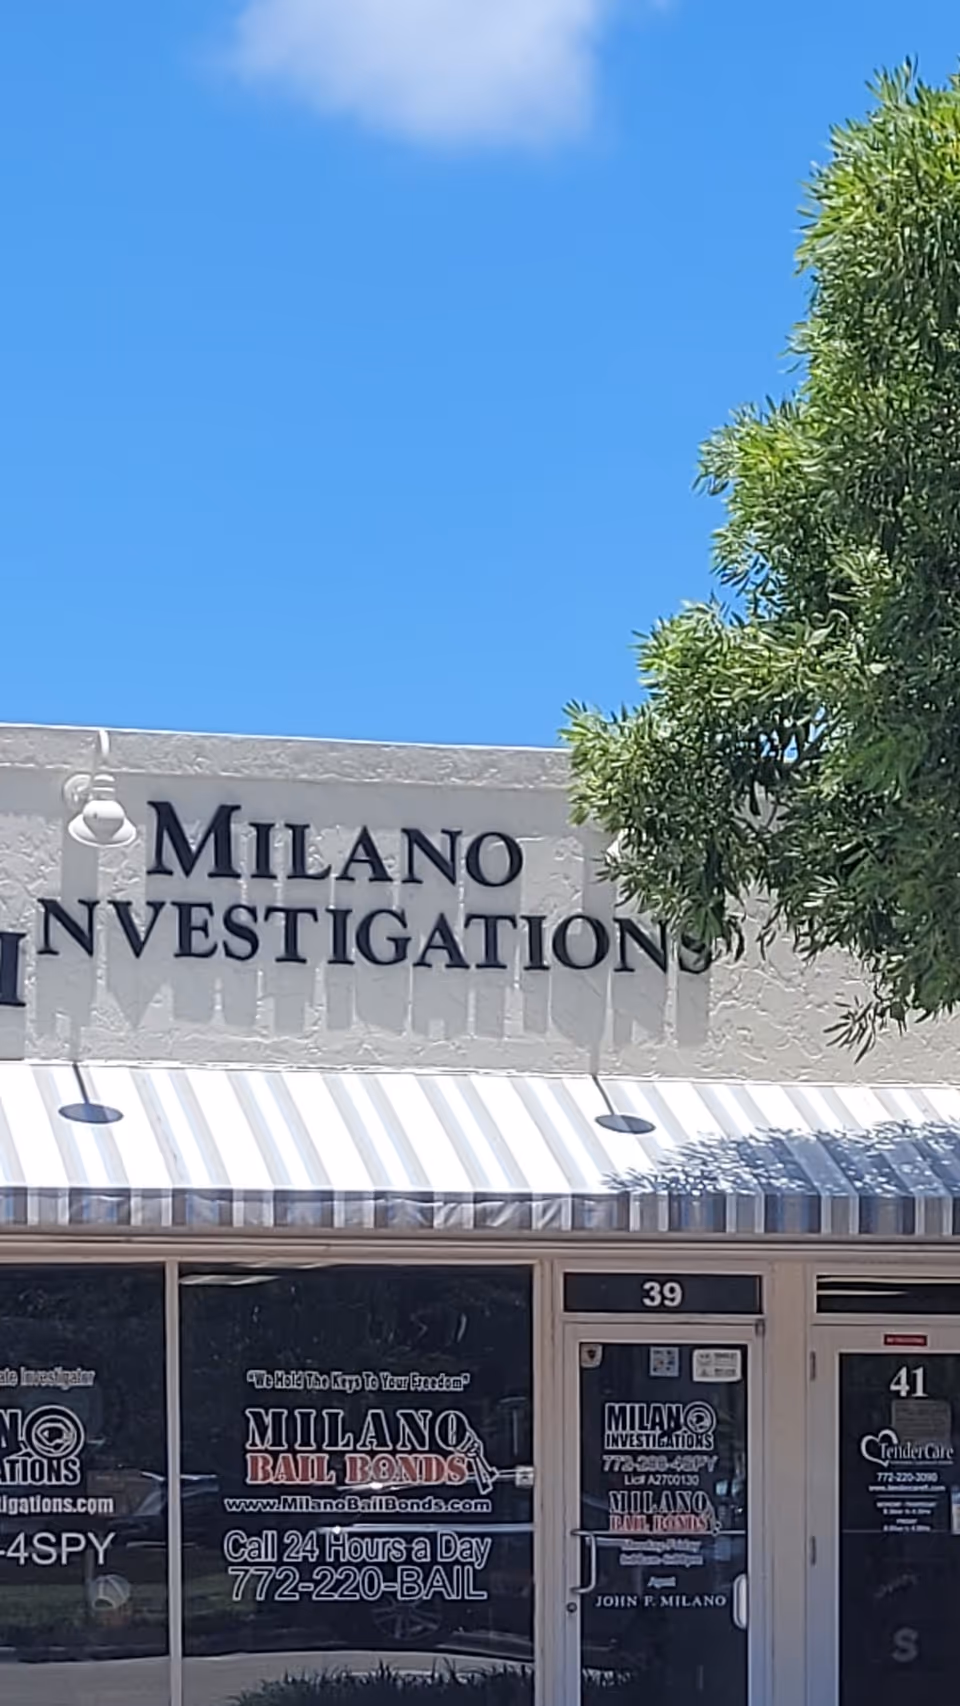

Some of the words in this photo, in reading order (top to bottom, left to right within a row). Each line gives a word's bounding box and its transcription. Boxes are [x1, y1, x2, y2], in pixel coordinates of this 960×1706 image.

[146, 801, 524, 887] MILANO
[642, 1281, 682, 1307] 39
[274, 1370, 302, 1389] Hold
[306, 1371, 330, 1389] The
[332, 1372, 361, 1393] Keys
[363, 1373, 378, 1391] To
[381, 1373, 408, 1391] Your
[890, 1366, 928, 1397] 41
[245, 1408, 470, 1451] MILANO
[605, 1432, 714, 1450] INVESTIGATIONS
[879, 1441, 954, 1460] TenderCare
[246, 1453, 336, 1485] BAIL
[345, 1453, 468, 1485] BONDS
[224, 1496, 491, 1513] www.MilanoBailBonds.com
[609, 1490, 709, 1514] MILANO
[609, 1514, 647, 1532] BAIL
[653, 1514, 708, 1532] BONDS
[224, 1530, 277, 1562] Call
[283, 1531, 319, 1563] 24
[326, 1531, 407, 1563] Hours
[412, 1537, 431, 1562] a
[438, 1532, 491, 1569] Day
[228, 1566, 488, 1601] 772-220-BAIL
[596, 1595, 638, 1608] JOHN
[660, 1595, 727, 1607] MILANO
